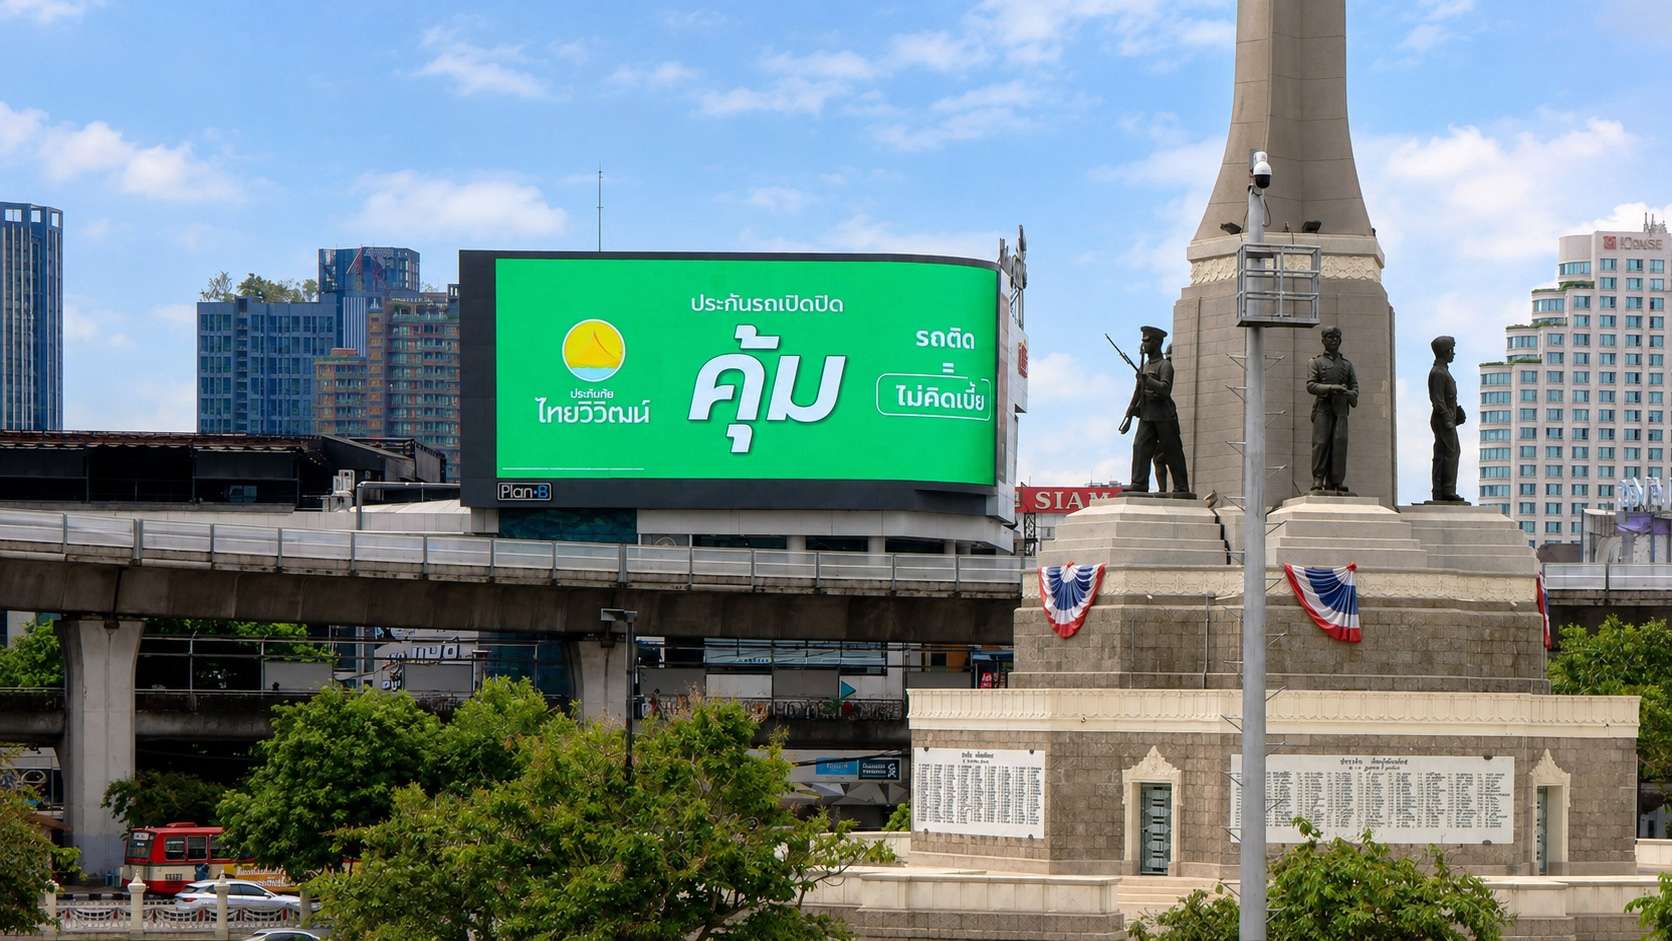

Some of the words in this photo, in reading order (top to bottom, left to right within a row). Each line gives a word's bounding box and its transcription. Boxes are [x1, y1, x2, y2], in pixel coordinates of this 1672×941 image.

[691, 293, 844, 313] ประกันรถเปิดปิด
[916, 327, 975, 349] รถติด
[688, 324, 846, 453] คุ้ม
[895, 382, 985, 411] ไม่คิดเบี้ย
